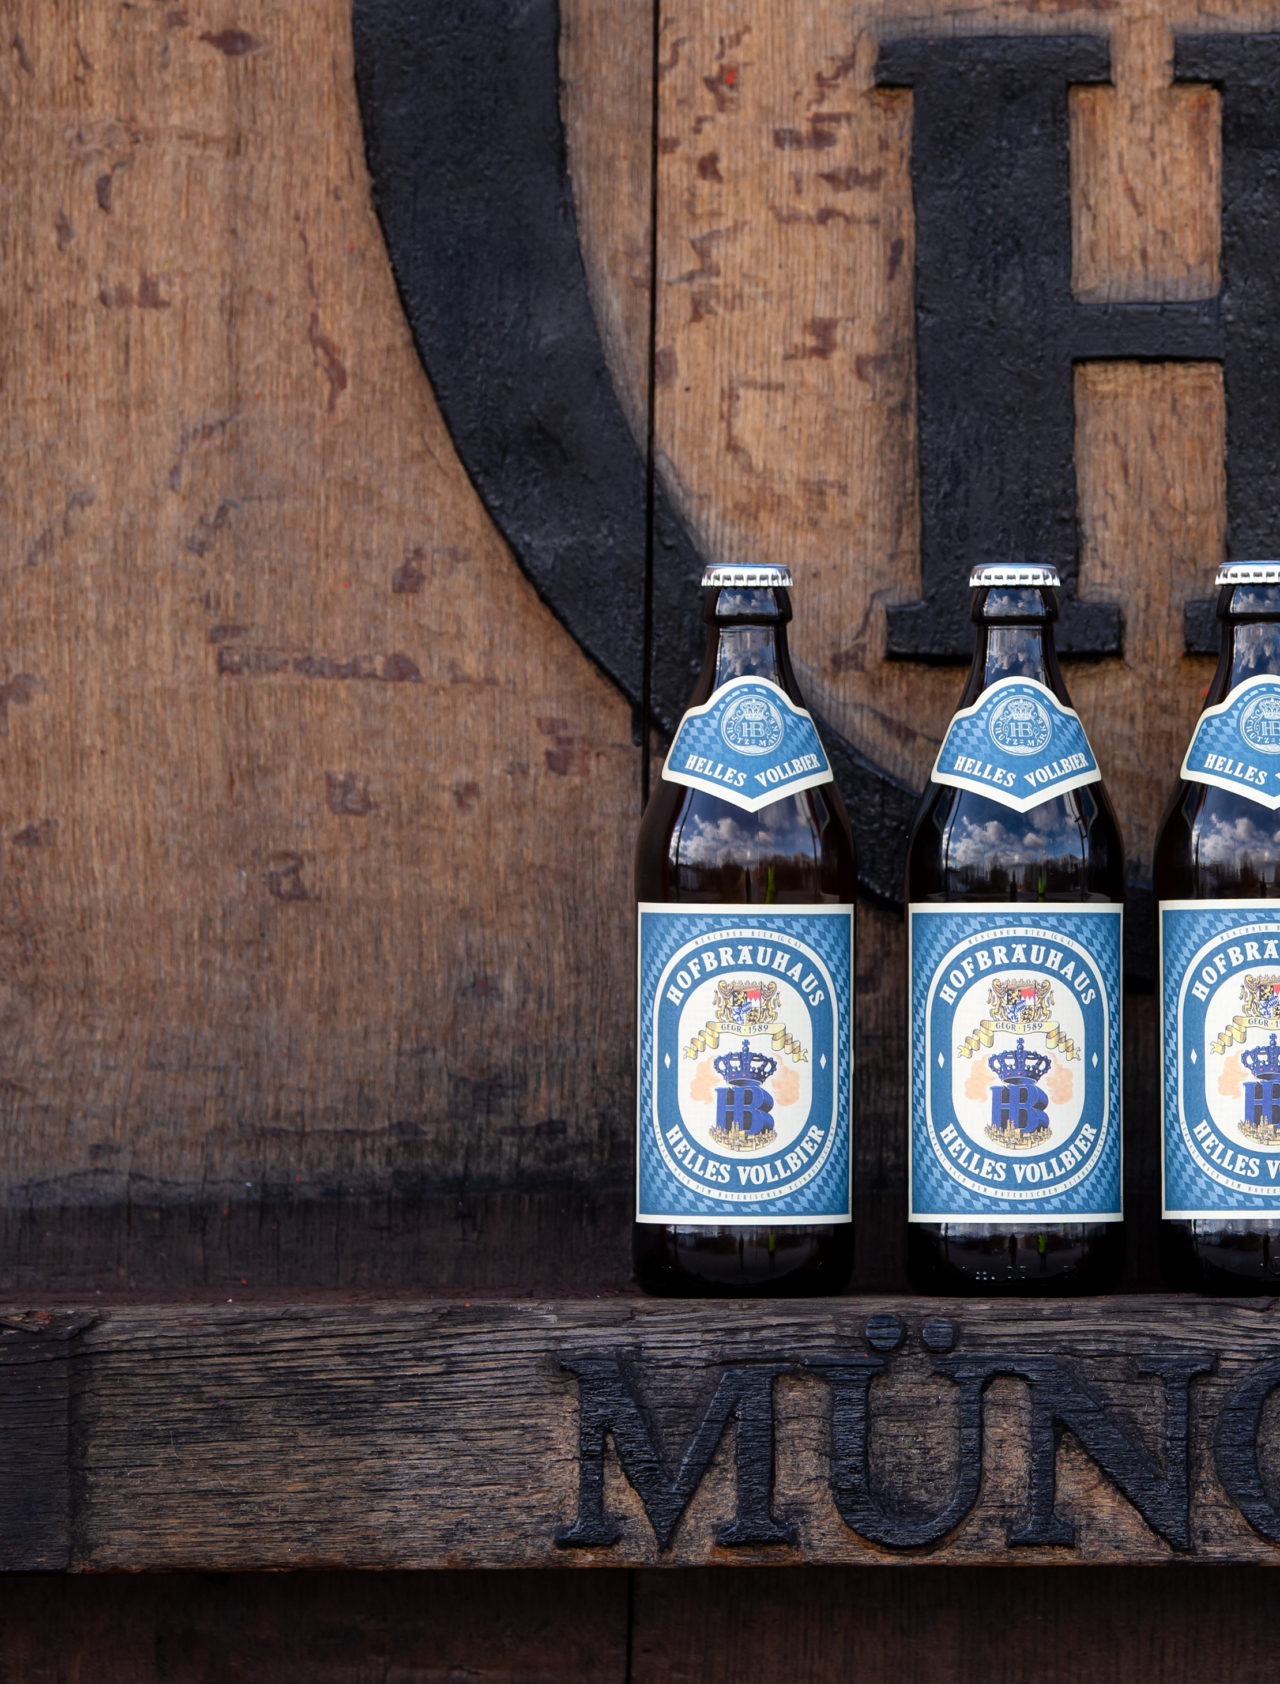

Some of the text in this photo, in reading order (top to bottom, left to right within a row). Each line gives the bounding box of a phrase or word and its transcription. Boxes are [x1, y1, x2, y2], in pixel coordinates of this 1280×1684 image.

[741, 722, 765, 738] HB
[1009, 721, 1033, 738] HB
[684, 753, 820, 787] HELLES VOLLBIER
[953, 752, 1089, 787] HELLES VOLLBIER
[1203, 753, 1268, 785] HELLES
[666, 945, 825, 1006] HOFBRÄUHAUS
[939, 944, 1097, 1006] HOFBRÄUHAUS
[748, 1024, 769, 1033] 1589
[1023, 1022, 1043, 1031] 1589
[665, 1123, 731, 1184] HELLES
[737, 1124, 825, 1185] VOLLBIER
[940, 1123, 1006, 1182] HELLES
[1013, 1123, 1098, 1184] VOLLBIER
[1192, 1119, 1260, 1178] HELLES
